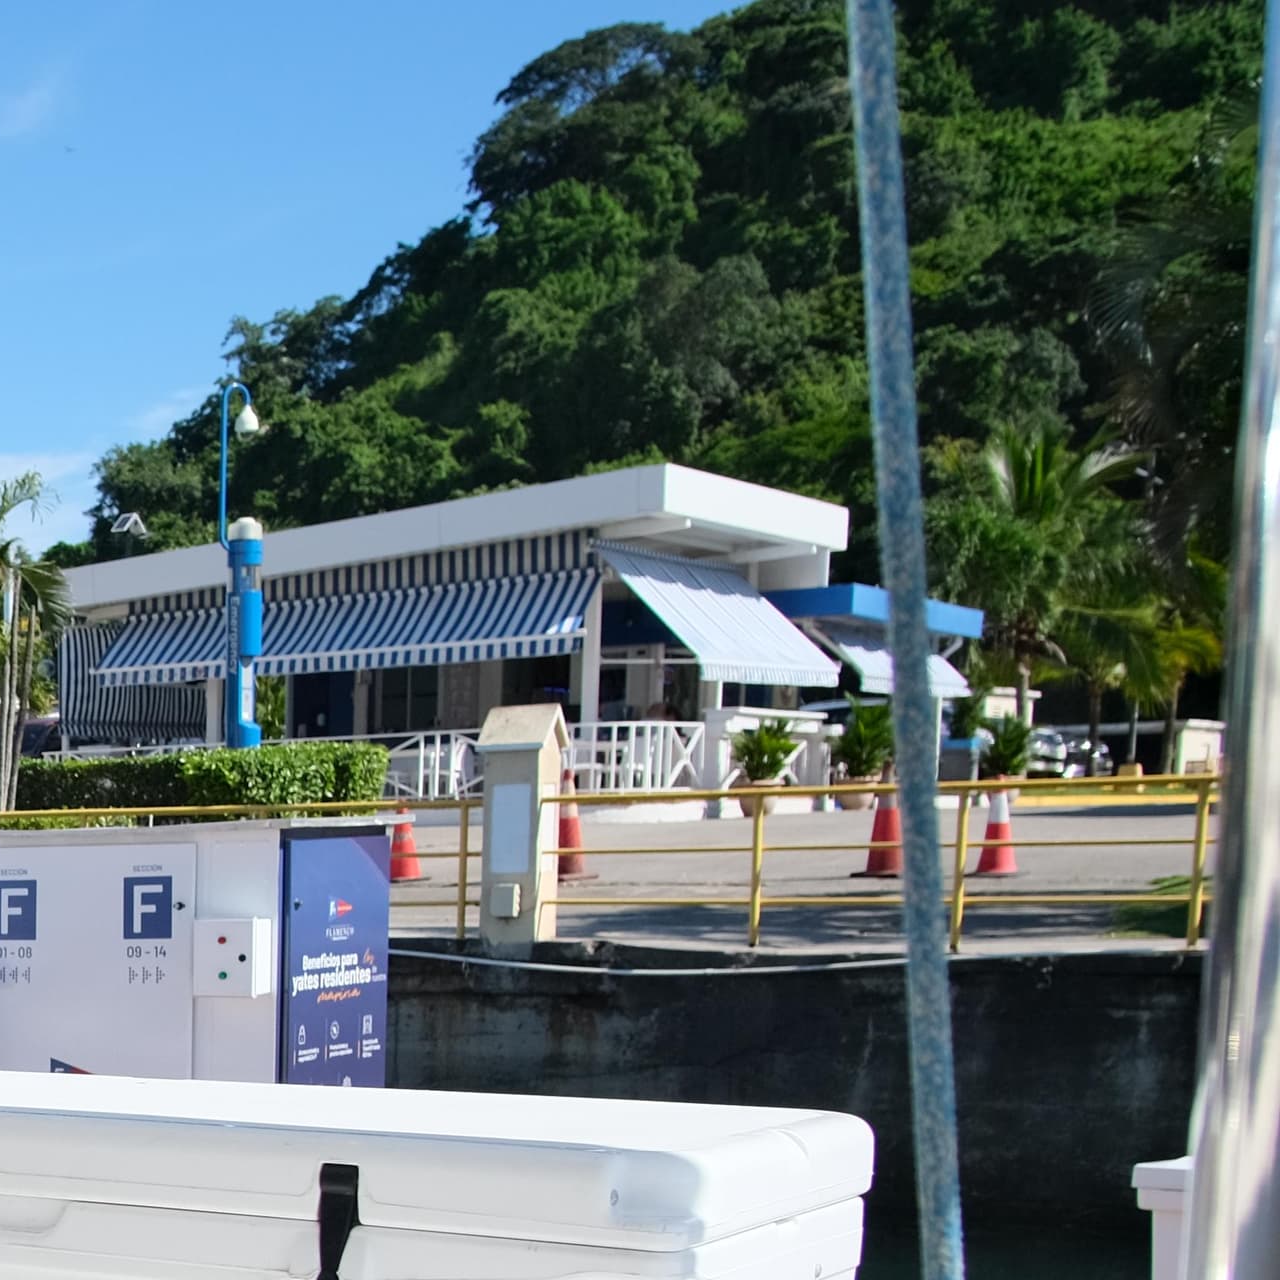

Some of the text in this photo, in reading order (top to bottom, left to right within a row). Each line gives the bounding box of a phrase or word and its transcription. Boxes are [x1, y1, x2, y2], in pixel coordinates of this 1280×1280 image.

[229, 595, 240, 674] Emergency
[1, 888, 29, 935] F
[133, 884, 164, 934] F
[17, 946, 32, 958] 08
[126, 945, 142, 958] 09
[154, 945, 167, 958] 14
[302, 952, 340, 971] Beneficios
[341, 952, 358, 968] para
[292, 965, 371, 997] yates residentes
